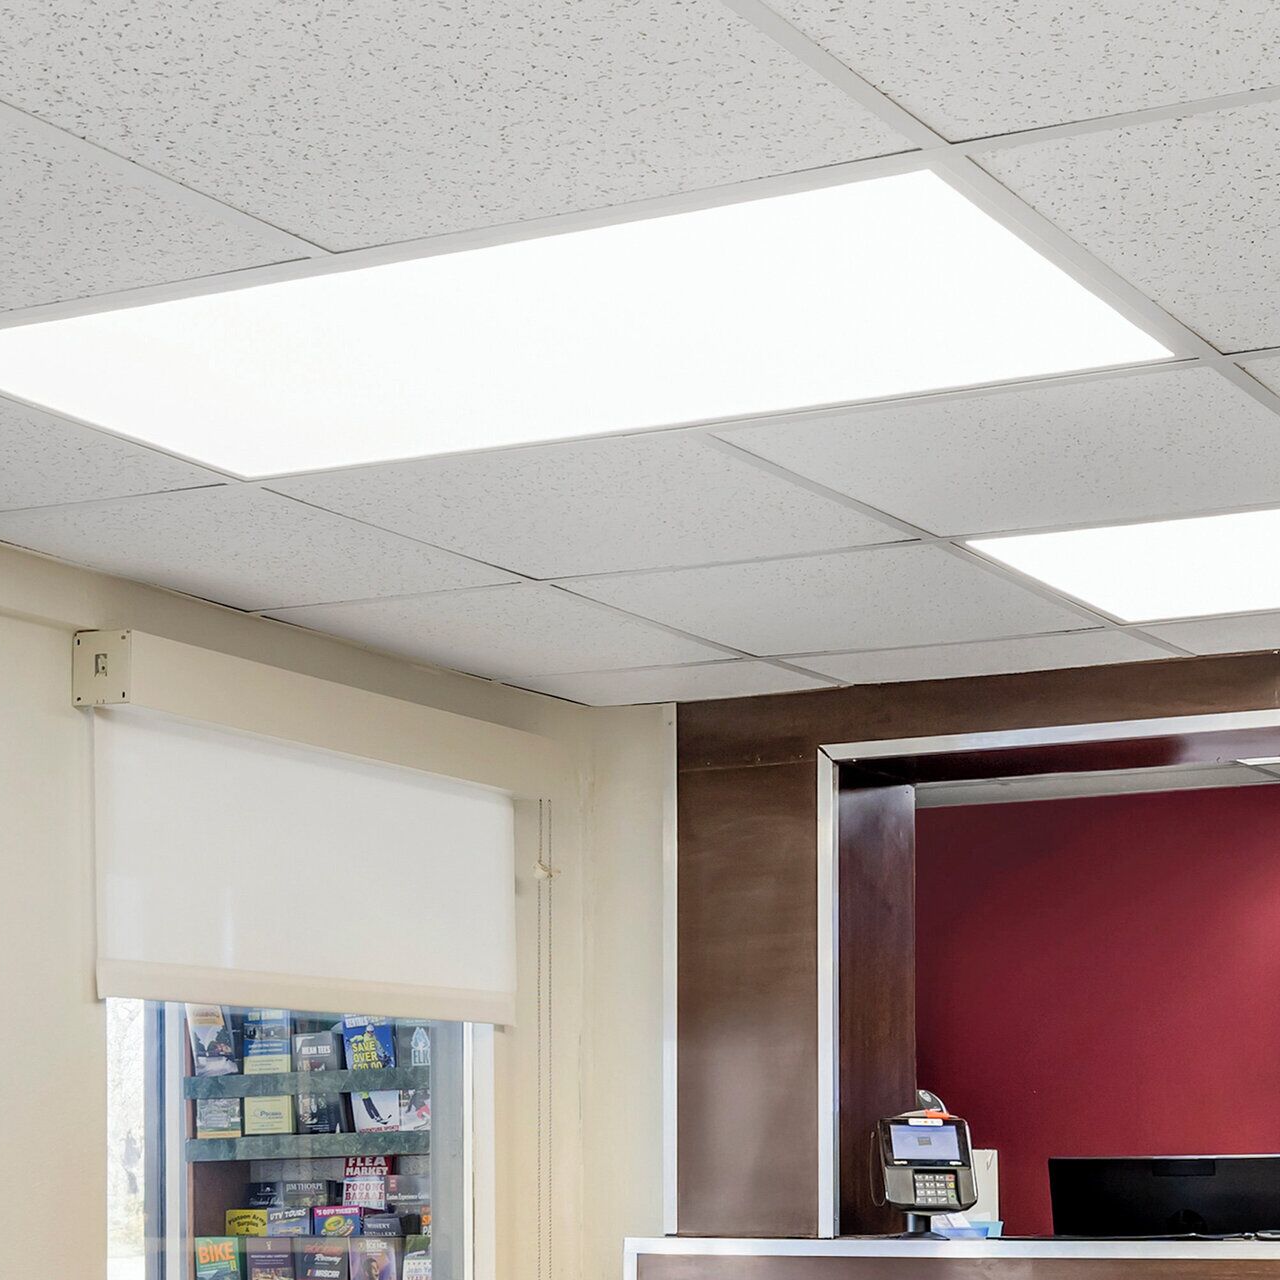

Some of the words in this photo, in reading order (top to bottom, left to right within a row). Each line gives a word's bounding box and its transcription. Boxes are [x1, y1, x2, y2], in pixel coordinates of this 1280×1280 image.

[351, 1041, 377, 1052] SAVE
[353, 1052, 379, 1062] OVER
[348, 1157, 387, 1166] FLEA
[345, 1167, 389, 1176] MARKET
[285, 1209, 307, 1218] TOURS
[198, 1241, 236, 1264] BIKE
[315, 1270, 340, 1279] NASCAR
